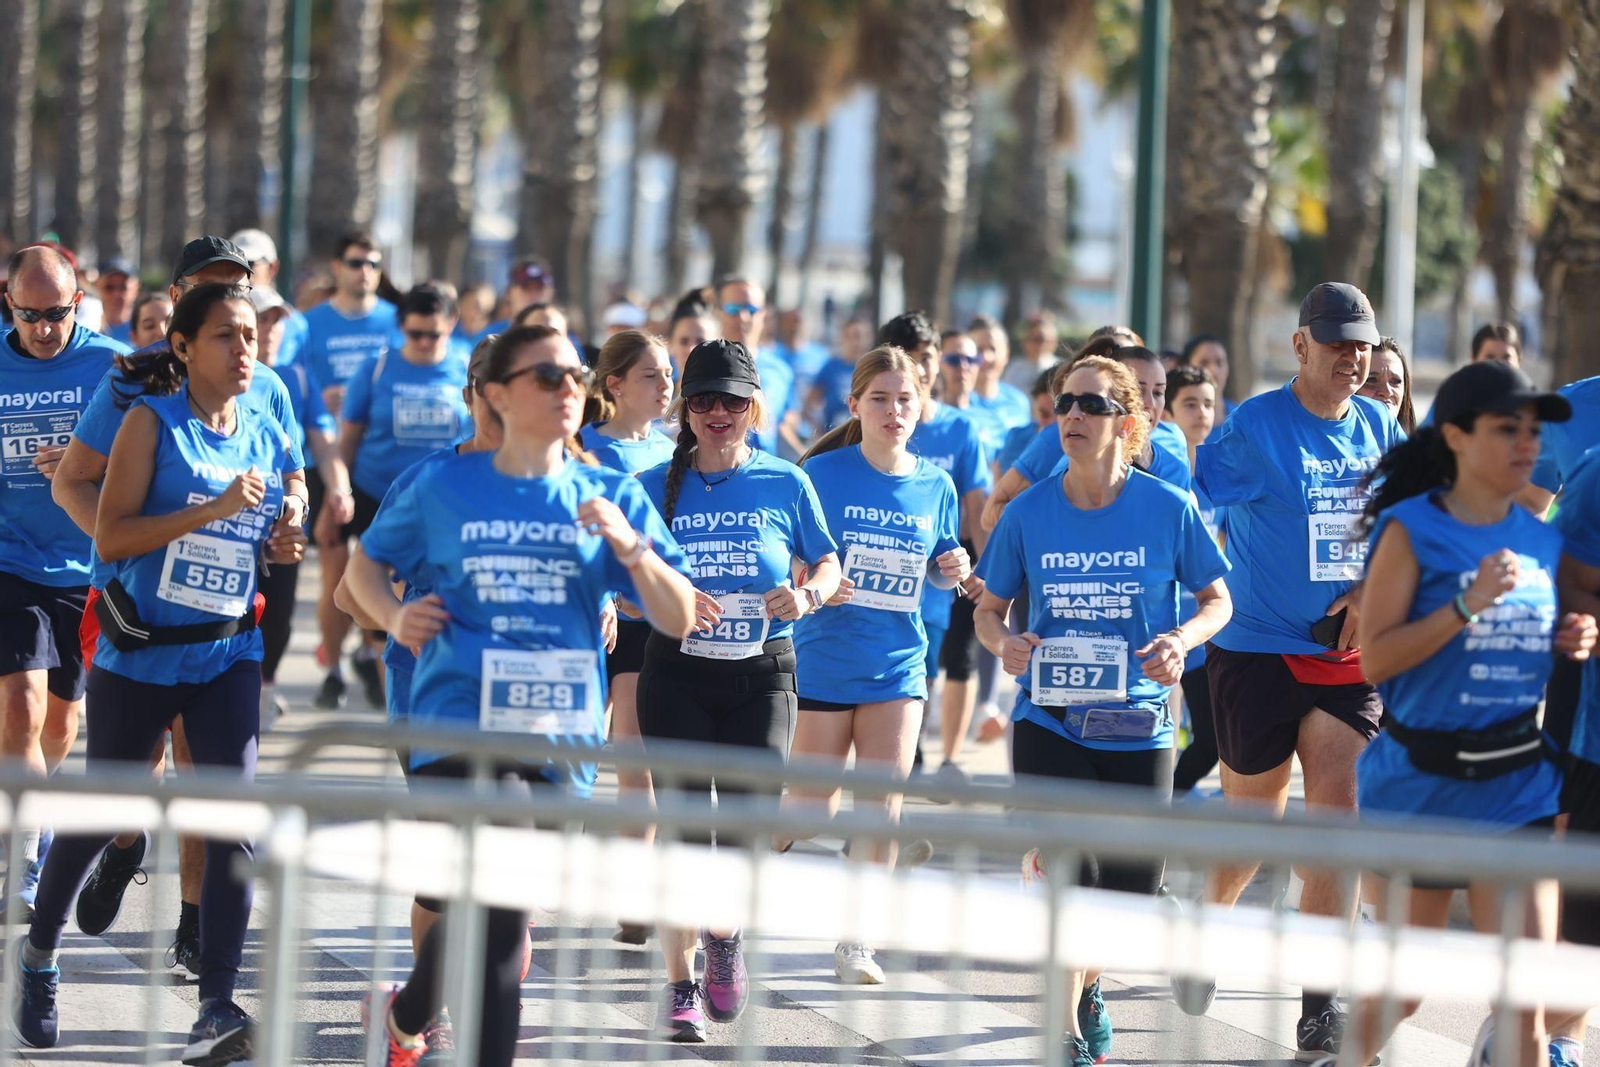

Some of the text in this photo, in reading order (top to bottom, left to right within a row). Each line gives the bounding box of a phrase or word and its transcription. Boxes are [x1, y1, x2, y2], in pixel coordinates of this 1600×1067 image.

[1316, 499, 1369, 511] MAKE
[671, 509, 768, 532] mayoral
[844, 505, 932, 531] mayoral
[188, 541, 217, 554] Carrera
[843, 531, 926, 555] RUNNING
[187, 550, 220, 562] Solidaria
[861, 555, 884, 563] Carrera
[1041, 546, 1145, 573] mayoral
[860, 560, 887, 569] Solidaria
[185, 564, 241, 594] 558
[853, 571, 914, 595] 1170
[1042, 582, 1140, 596] RUNNING
[1051, 596, 1132, 608] MAKES
[1051, 608, 1133, 621] FRIENDS
[1049, 644, 1074, 652] Carrera
[1092, 643, 1121, 652] mayoral
[1048, 651, 1079, 659] Solidaria
[1051, 665, 1104, 687] 587
[507, 682, 574, 709] 829
